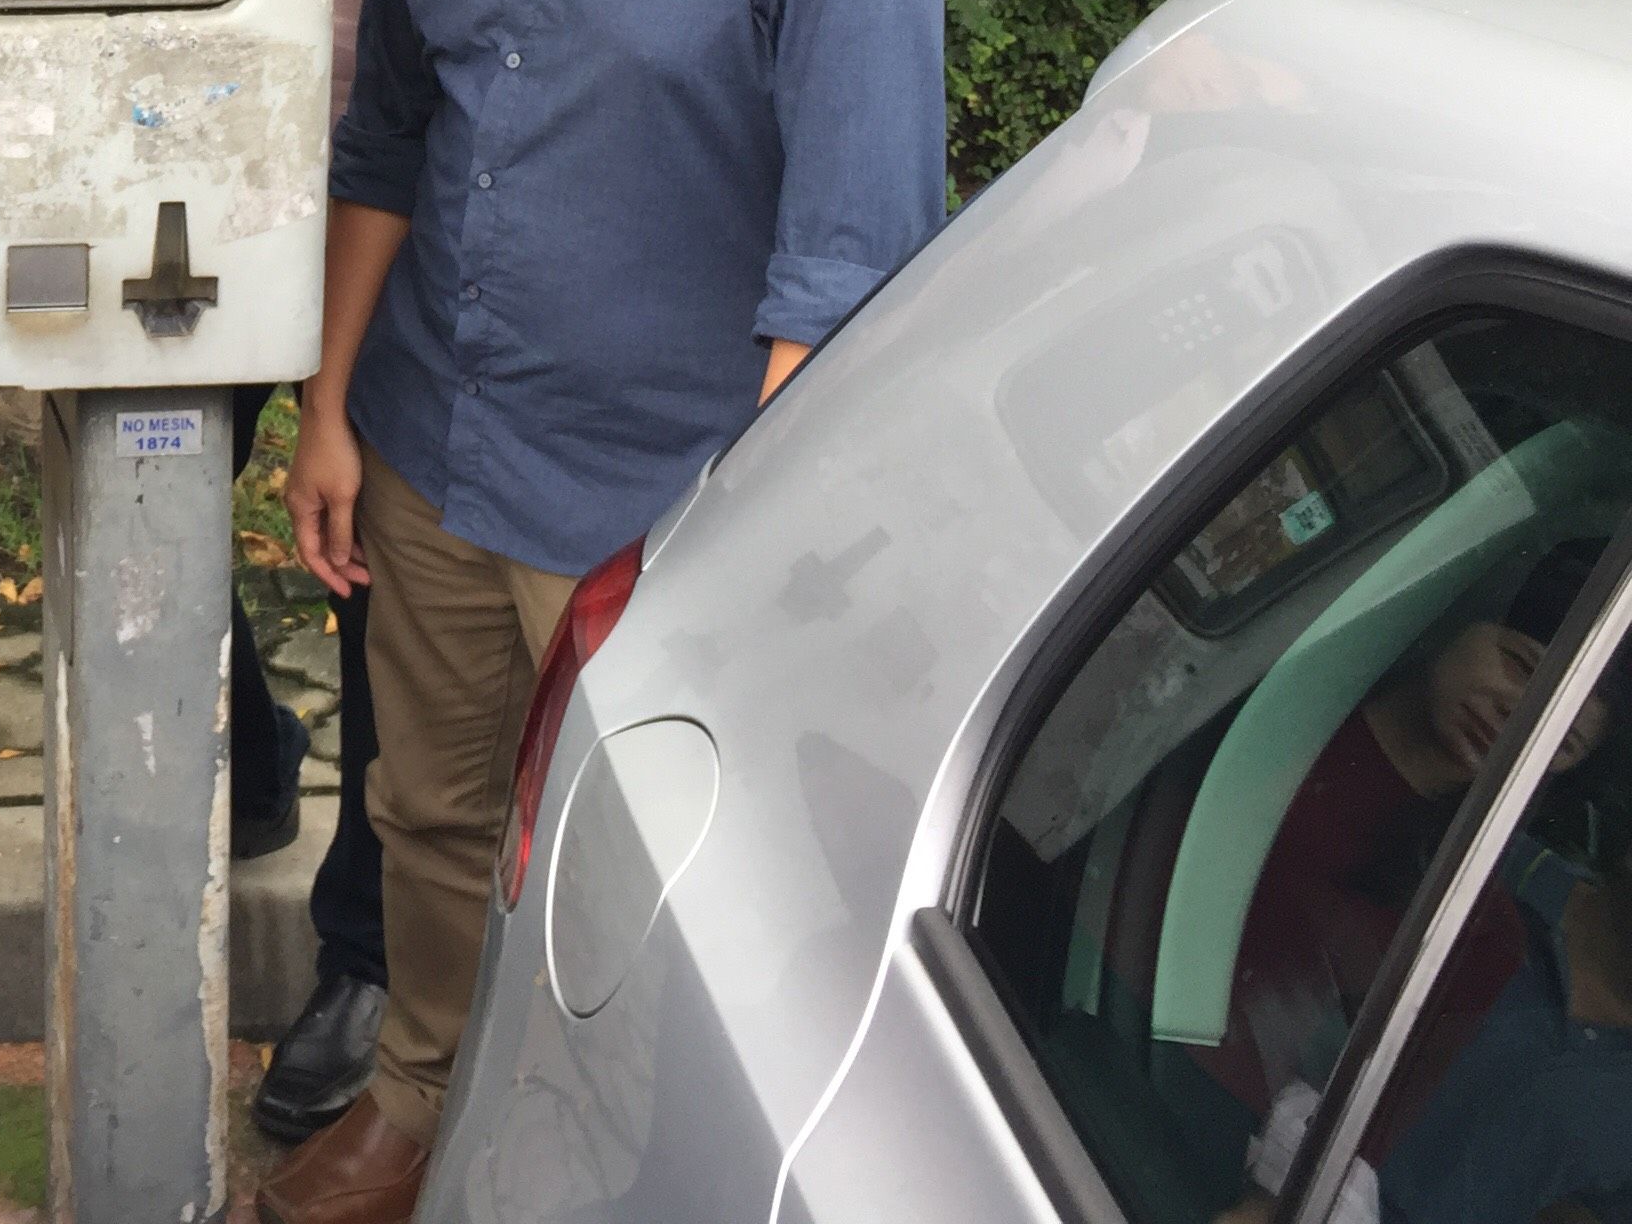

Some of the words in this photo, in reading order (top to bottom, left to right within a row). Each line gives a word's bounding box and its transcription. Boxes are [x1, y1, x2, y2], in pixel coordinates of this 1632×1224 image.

[122, 418, 145, 432] NO
[149, 417, 196, 432] MESIN
[135, 436, 182, 451] 1874
